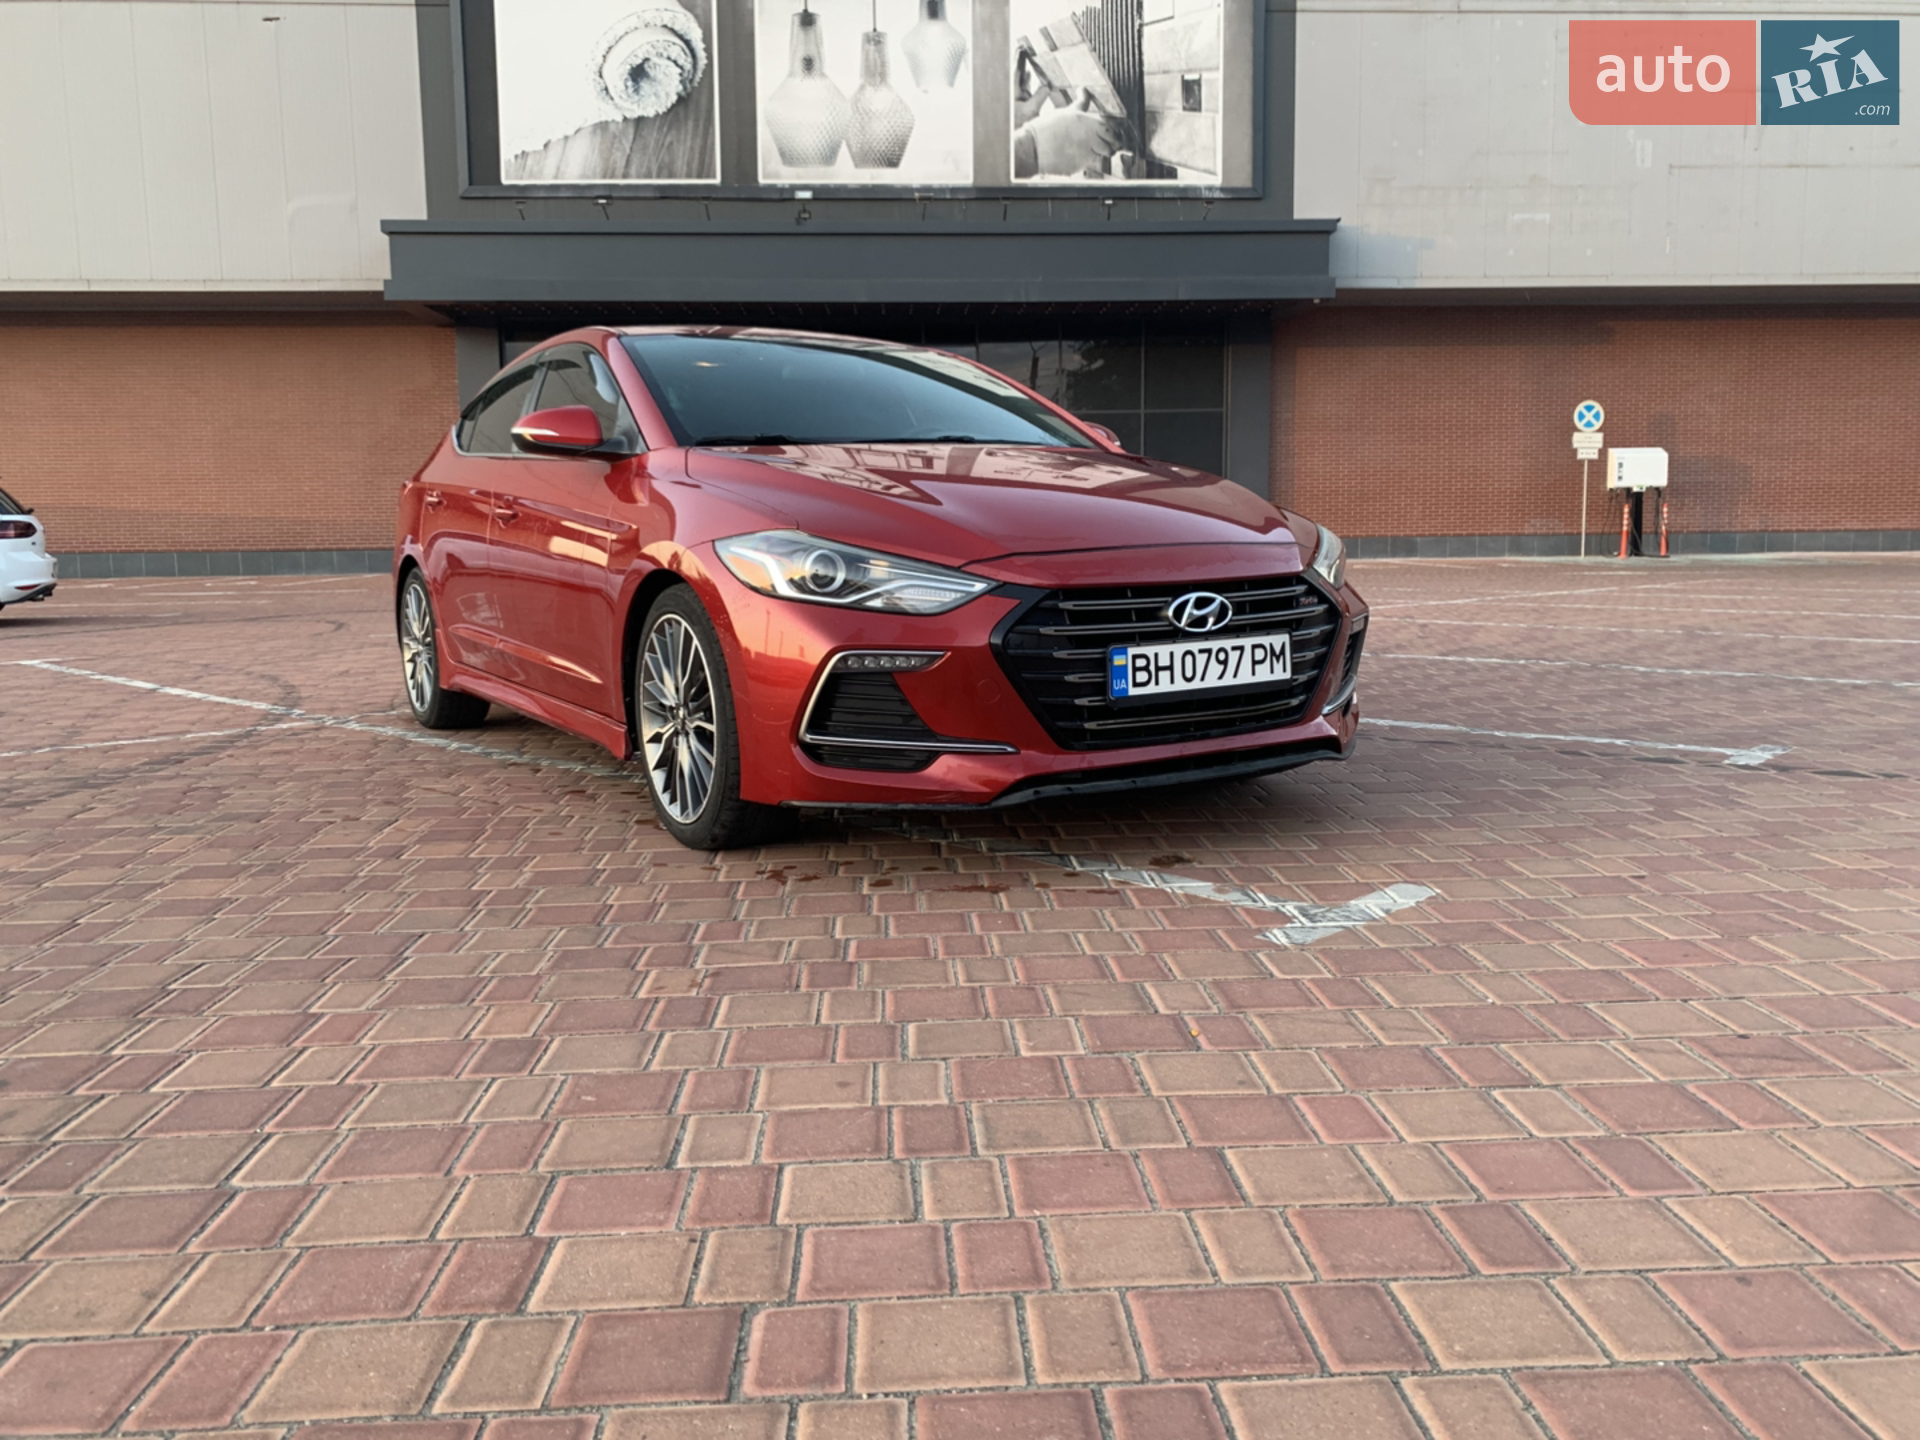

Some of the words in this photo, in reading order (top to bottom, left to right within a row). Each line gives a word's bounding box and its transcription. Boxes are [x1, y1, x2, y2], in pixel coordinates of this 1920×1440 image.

[1131, 650, 1175, 688] BH
[1181, 644, 1245, 683] 0797
[1251, 640, 1287, 677] PM
[1113, 678, 1128, 690] UA
